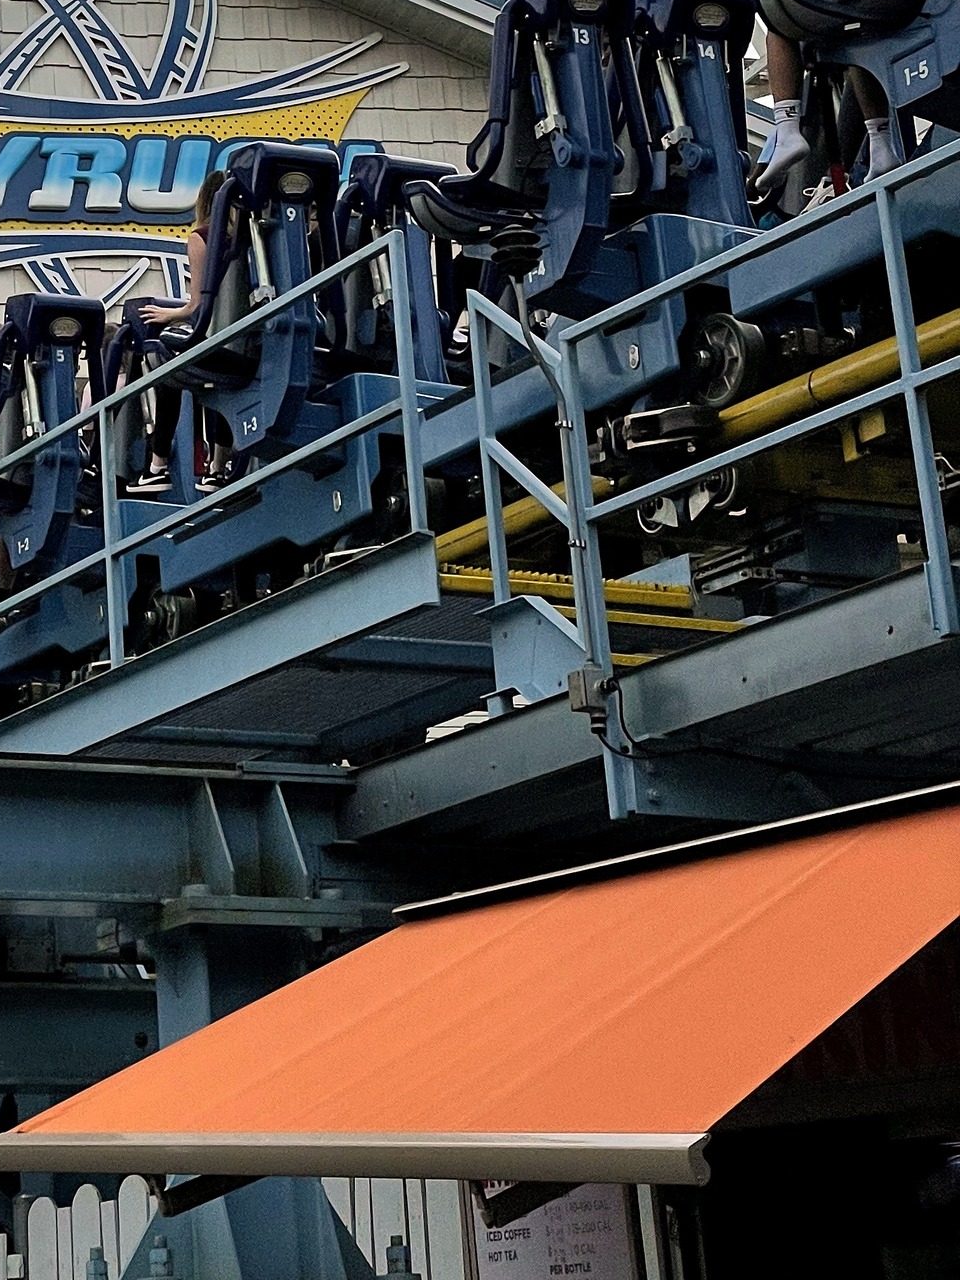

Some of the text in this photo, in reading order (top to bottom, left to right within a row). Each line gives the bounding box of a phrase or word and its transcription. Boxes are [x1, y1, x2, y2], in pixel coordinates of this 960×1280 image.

[572, 27, 590, 45] 13
[697, 43, 715, 60] 14
[903, 59, 929, 86] 1-5
[286, 207, 297, 222] 9
[56, 349, 65, 363] 5
[242, 416, 258, 436] 1-3
[486, 1230, 503, 1243] ICED
[504, 1227, 532, 1241] COFFEE
[488, 1250, 519, 1263] HOT TEA
[549, 1262, 592, 1276] PER BOTTLE
